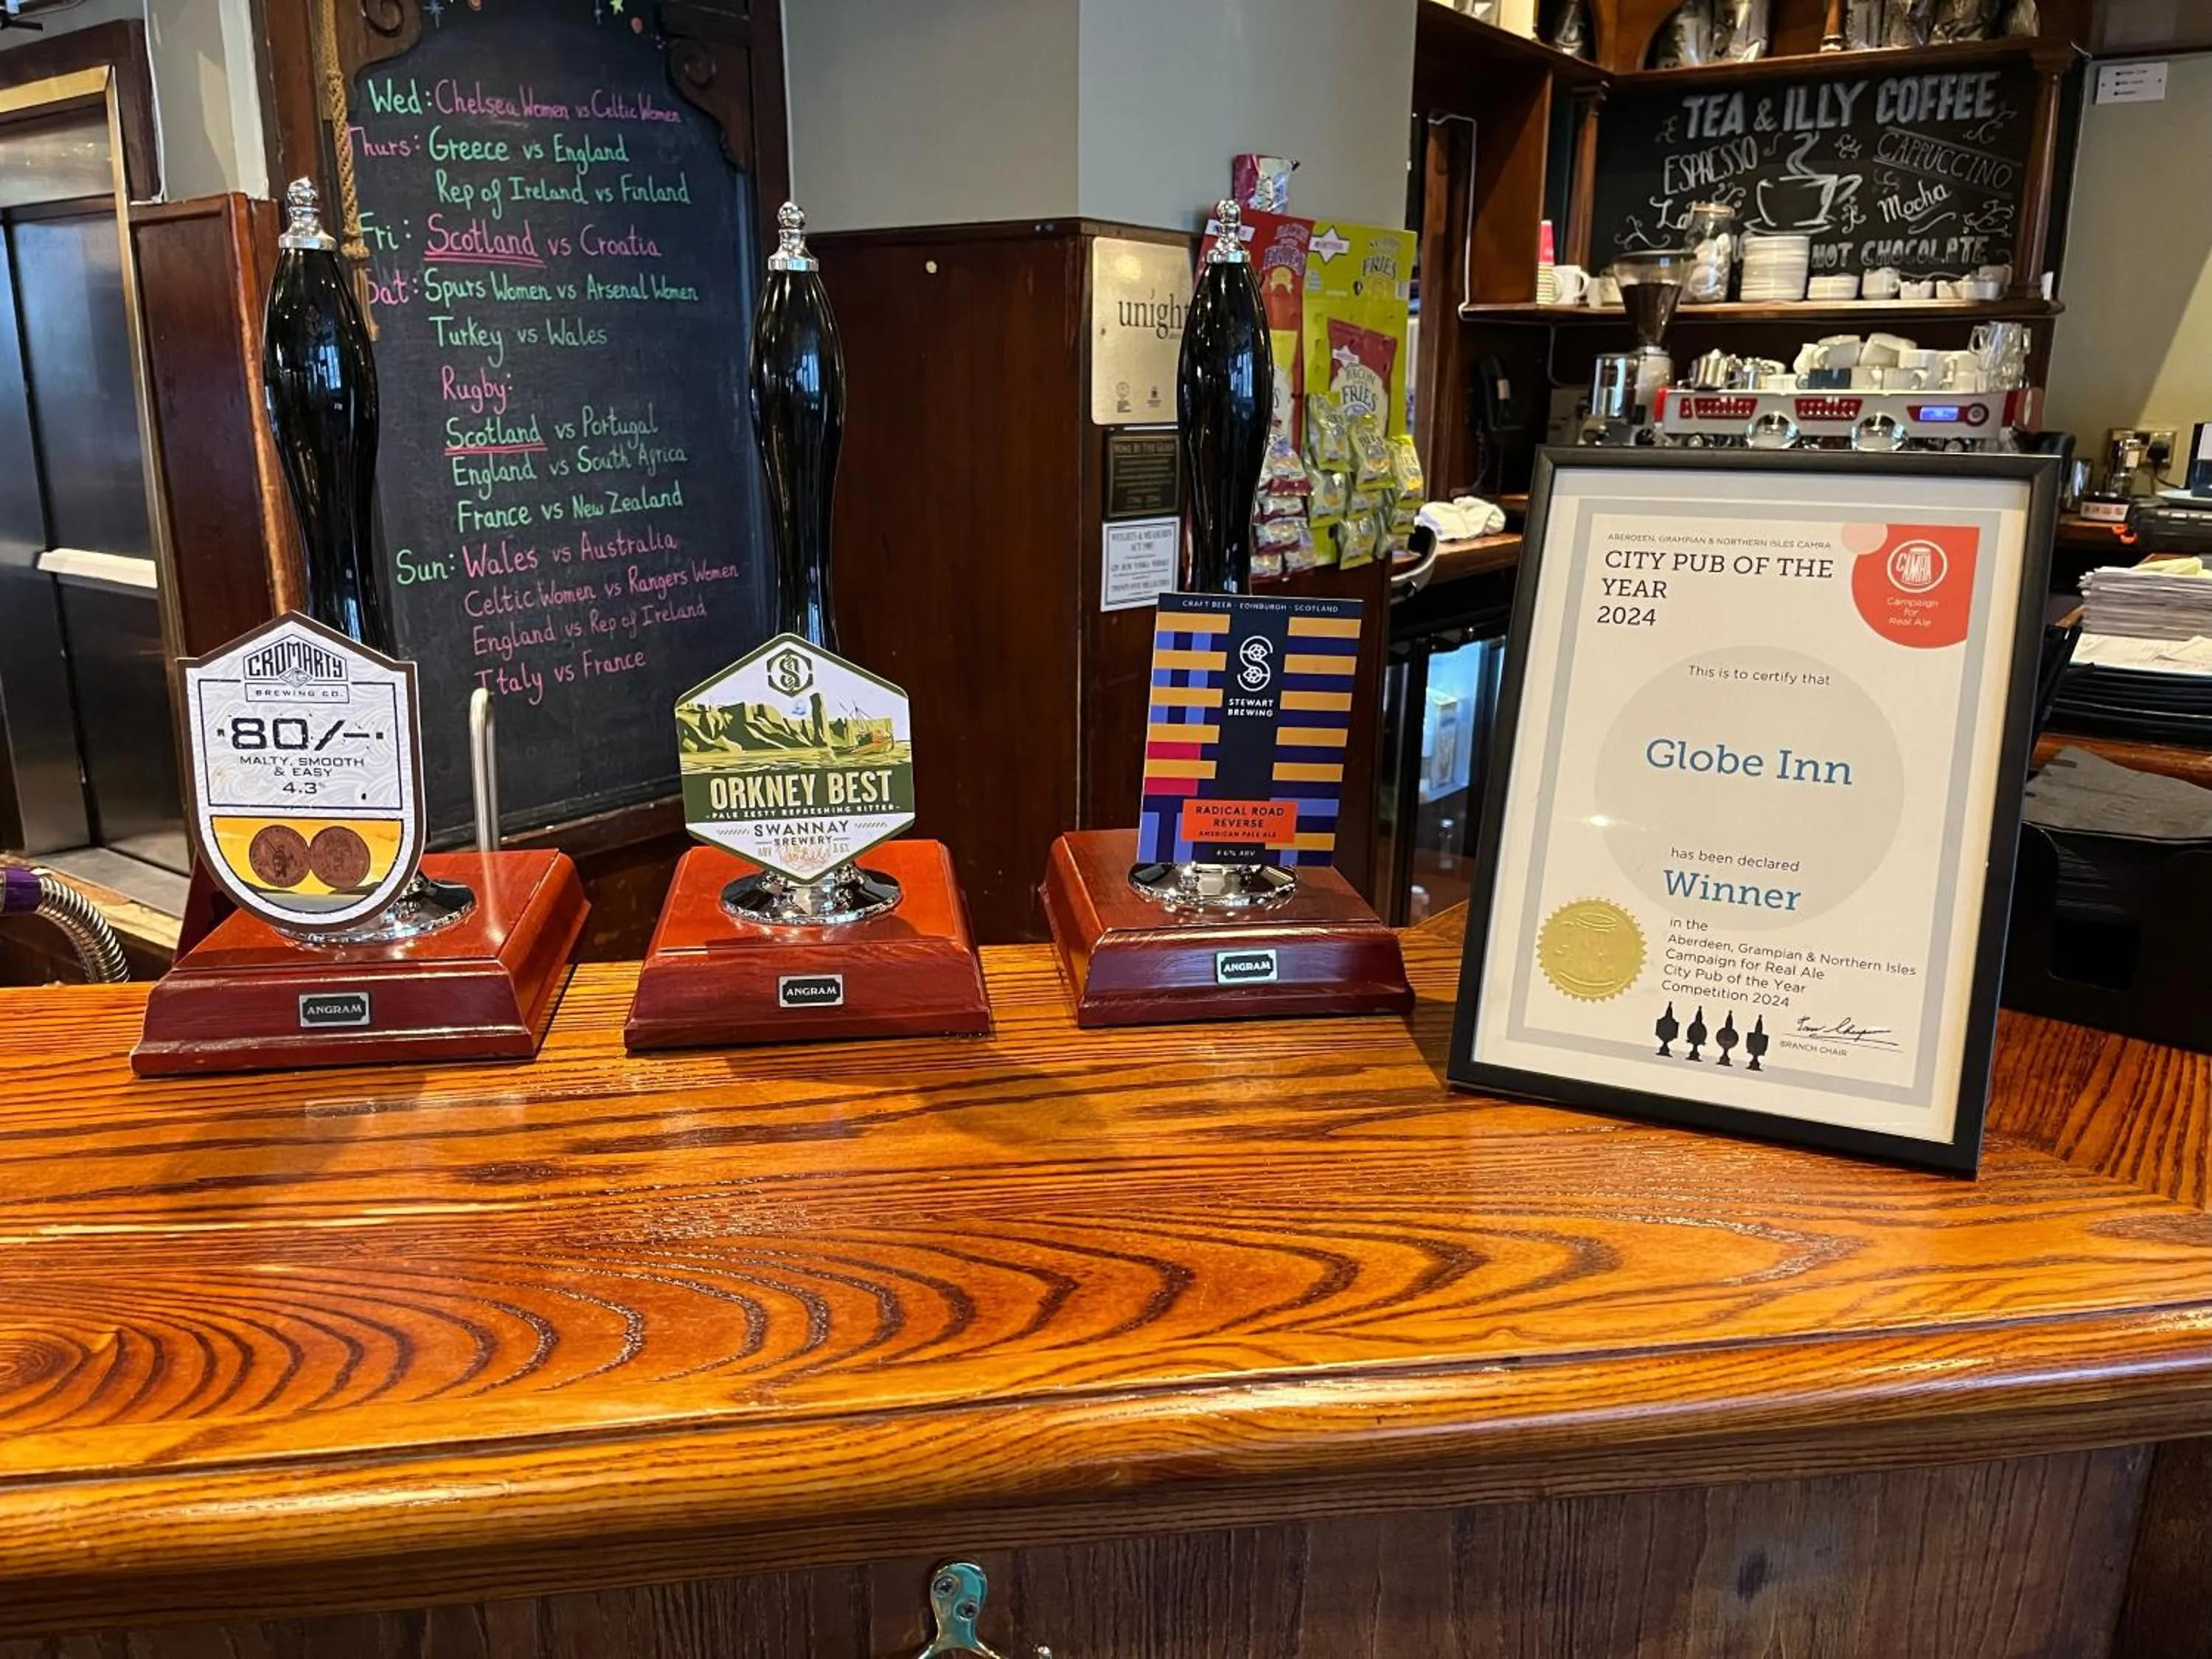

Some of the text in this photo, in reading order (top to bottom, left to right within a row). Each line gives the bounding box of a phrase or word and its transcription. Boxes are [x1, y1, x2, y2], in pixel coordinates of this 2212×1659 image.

[435, 79, 519, 118] Chelsea
[520, 86, 569, 120] Women
[576, 105, 590, 118] vs
[591, 90, 636, 120] Celtic
[638, 94, 681, 123] Women
[1682, 72, 2001, 139] TEA & ILLY COFFEE
[428, 125, 509, 161] Greece
[522, 142, 543, 159] vs
[553, 134, 630, 174] England
[1878, 132, 2012, 189] CAPPUCCINO
[1664, 136, 1758, 195] ESPRESSO
[437, 169, 692, 219] Rep of Ireland vs Finland
[1877, 179, 1952, 223] Mocha
[426, 213, 539, 255] Scotland
[547, 237, 572, 255] vs
[580, 223, 661, 258] Croatia
[1811, 236, 1989, 268] HOT CHOCOLATE
[423, 268, 485, 310] Spurs
[491, 272, 552, 301] Women
[557, 282, 577, 299] vs
[587, 274, 649, 300] Arsenal
[652, 275, 698, 302] Women
[1118, 288, 1189, 339] unigh
[428, 316, 608, 366] Turkey vs Wales
[1341, 385, 1377, 412] FRIES
[445, 403, 658, 450] Scotland vs Portugal
[451, 442, 688, 501] England vs South Africa
[456, 480, 683, 534] France vs New Zealand
[462, 543, 538, 580] Wales
[552, 546, 572, 564] vs
[580, 525, 678, 560] Australia
[1717, 538, 1767, 546] NORTHERN
[1797, 541, 1831, 549] CAMRA
[1605, 550, 1834, 579] CITY PUB OF THE
[464, 560, 739, 619] Celtic Women vs Rangers Women
[1602, 577, 1668, 599] YEAR
[1888, 597, 1938, 608] Campaign
[1239, 602, 1287, 611] EDINBURGH
[1294, 604, 1338, 613] SCOTLAND
[1597, 606, 1657, 626] 2024
[1889, 617, 1931, 627] Real Ale
[1904, 608, 1920, 616] for
[473, 598, 707, 662] England vs Rep of Ireland
[248, 641, 343, 678] CROMARTY
[474, 650, 647, 706] Italy vs France
[1689, 665, 1830, 686] This is to certify that
[1227, 709, 1273, 717] BREWING
[1228, 698, 1274, 707] STEWART
[274, 768, 332, 777] & EASY
[299, 757, 364, 768] SMOOTH
[1646, 739, 1852, 785] Globe Inn
[710, 771, 892, 810] ORKNEY BEST
[743, 810, 775, 819] ZESTY
[782, 806, 850, 817] REFRESHING
[1196, 806, 1284, 816] RADICAL ROAD
[1214, 818, 1264, 827] REVERSE
[754, 820, 849, 838] SWANNAY
[773, 836, 833, 846] BREWERY
[1671, 847, 1799, 872] has been declared
[1663, 869, 1801, 911] Winner
[1670, 919, 1708, 931] in the
[1224, 961, 1270, 973] ANGRAM
[1666, 949, 1825, 980] Campaign for Real Ale
[1668, 934, 1917, 976] Aberdeen, Grampian & Northern Isles
[787, 986, 837, 996] ANGRAM
[1663, 964, 1806, 994] City Pub of the Year
[1661, 980, 1790, 1008] Competition 2024
[307, 1004, 362, 1015] ANGRAM
[1780, 1041, 1848, 1057] BRANCH CHAIR
